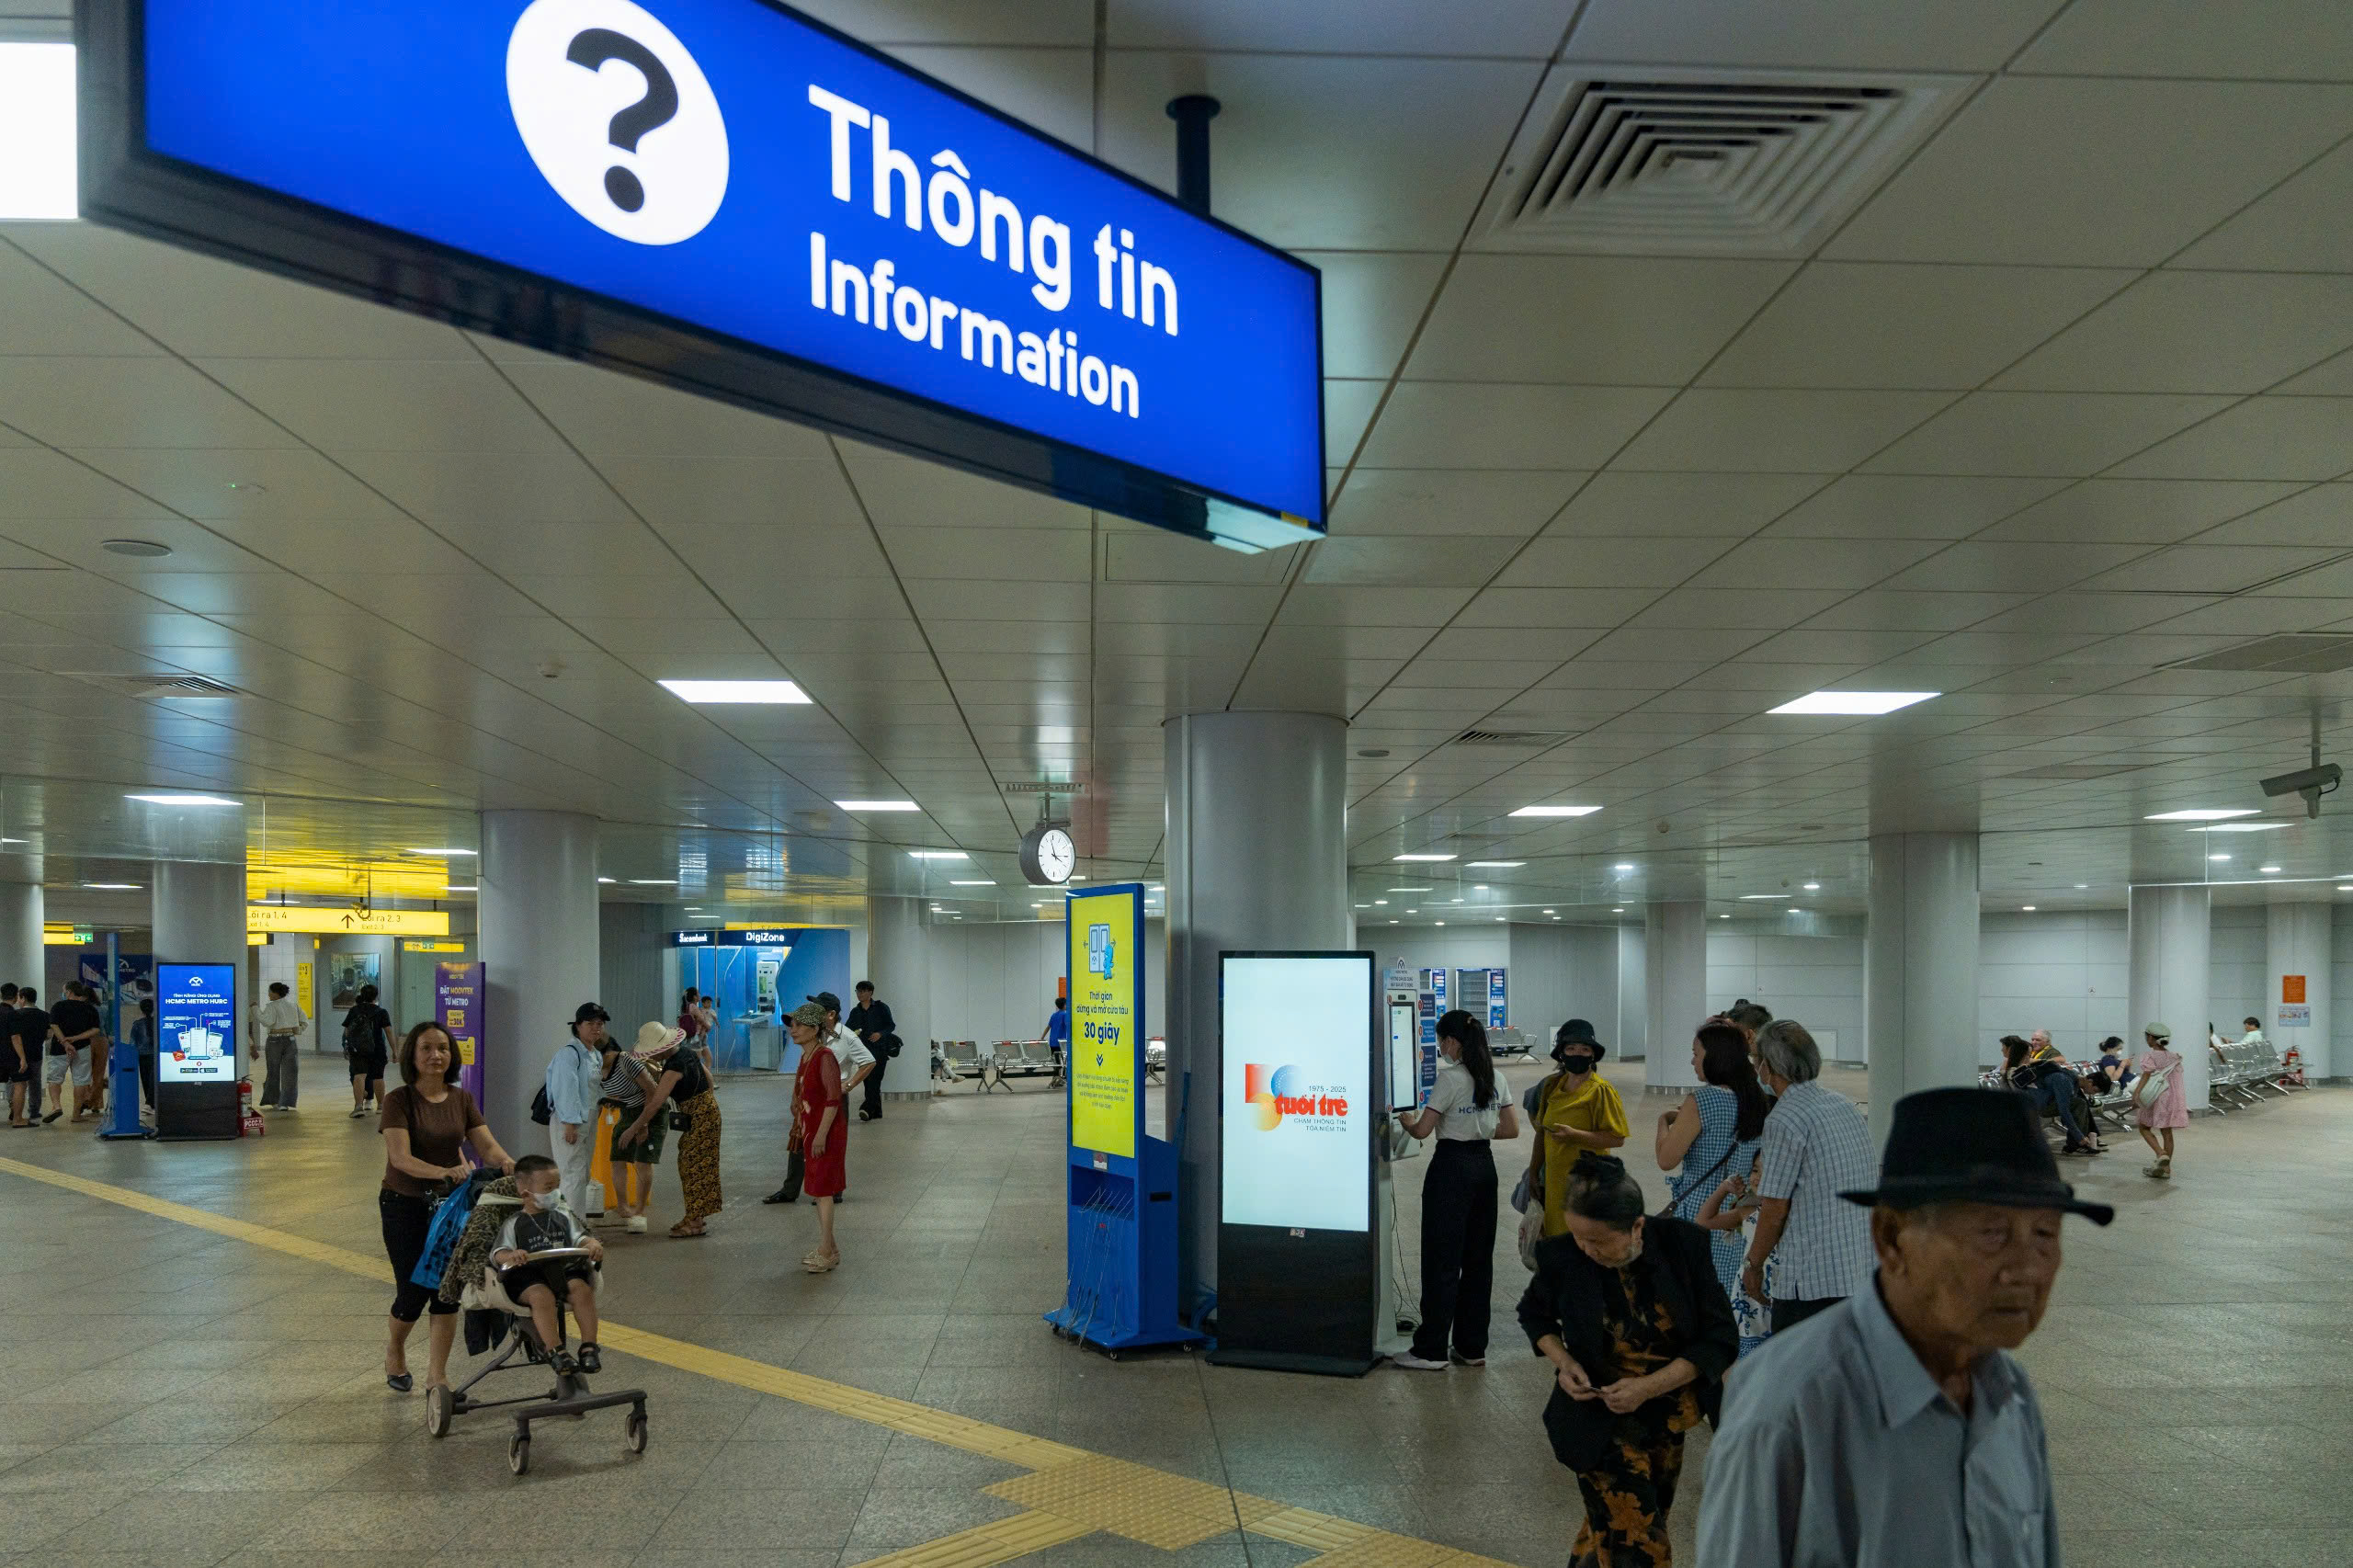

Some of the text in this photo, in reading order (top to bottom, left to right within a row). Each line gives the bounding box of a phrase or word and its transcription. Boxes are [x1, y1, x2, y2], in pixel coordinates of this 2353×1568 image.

[808, 84, 1178, 336] Thông tin
[810, 231, 1140, 419] Information
[281, 911, 287, 919] 4
[396, 915, 401, 923] 3
[679, 932, 708, 943] Sacombank
[745, 932, 785, 943] DigiZone
[1101, 992, 1113, 1003] gian
[1085, 1021, 1120, 1046] 30 giây
